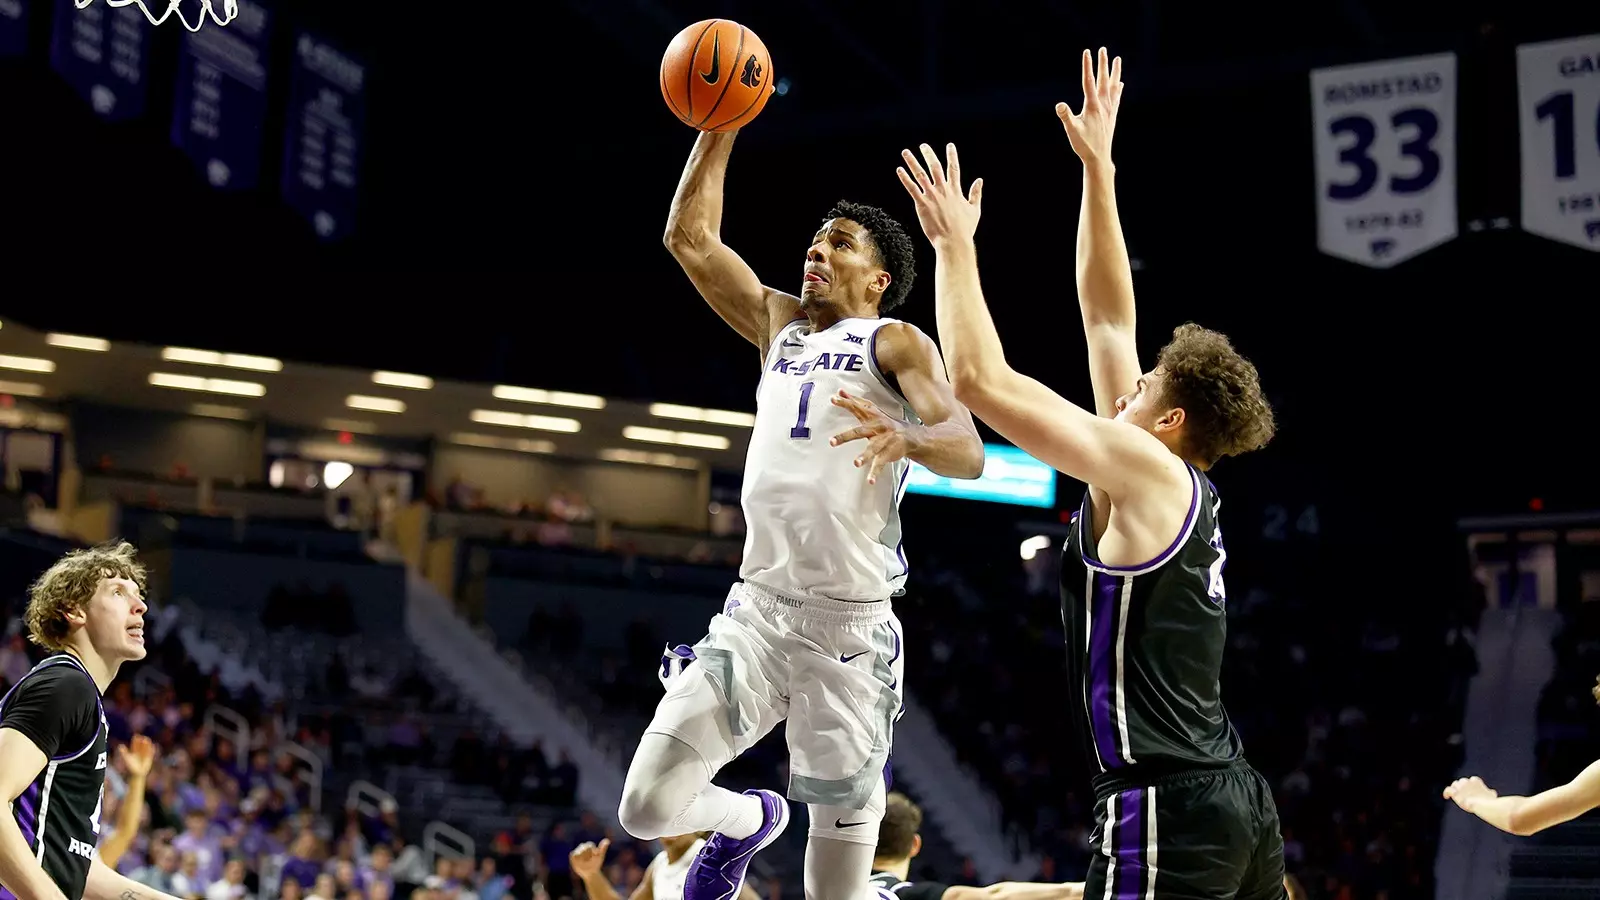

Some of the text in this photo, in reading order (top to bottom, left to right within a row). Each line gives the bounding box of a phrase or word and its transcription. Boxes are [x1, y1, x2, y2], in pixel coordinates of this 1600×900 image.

[1328, 107, 1440, 201] 33
[1536, 89, 1600, 180] 1
[772, 353, 865, 376] K-SATE
[791, 382, 814, 438] 1
[1263, 505, 1319, 538] 24
[776, 595, 804, 608] FAMILY
